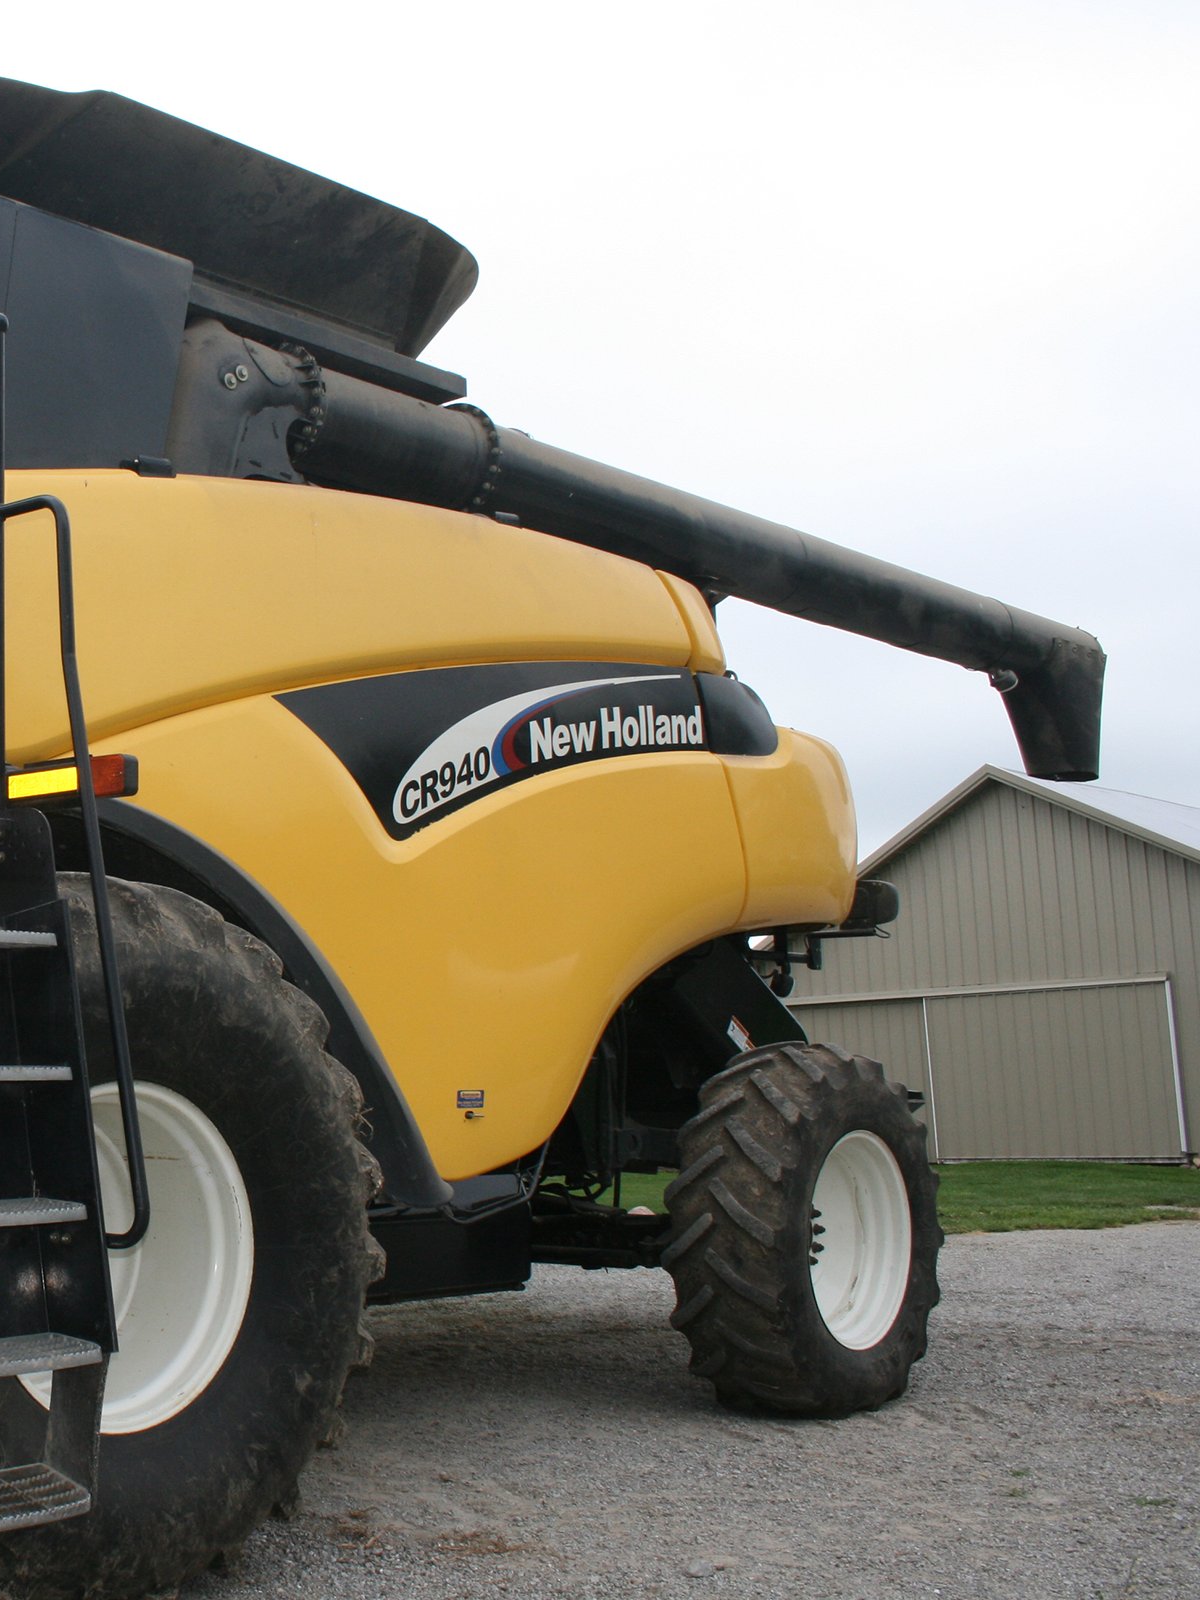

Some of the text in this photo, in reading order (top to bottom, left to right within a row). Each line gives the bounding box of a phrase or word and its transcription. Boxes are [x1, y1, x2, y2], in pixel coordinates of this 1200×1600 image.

[529, 705, 703, 763] New Holland
[400, 746, 490, 818] CR940
